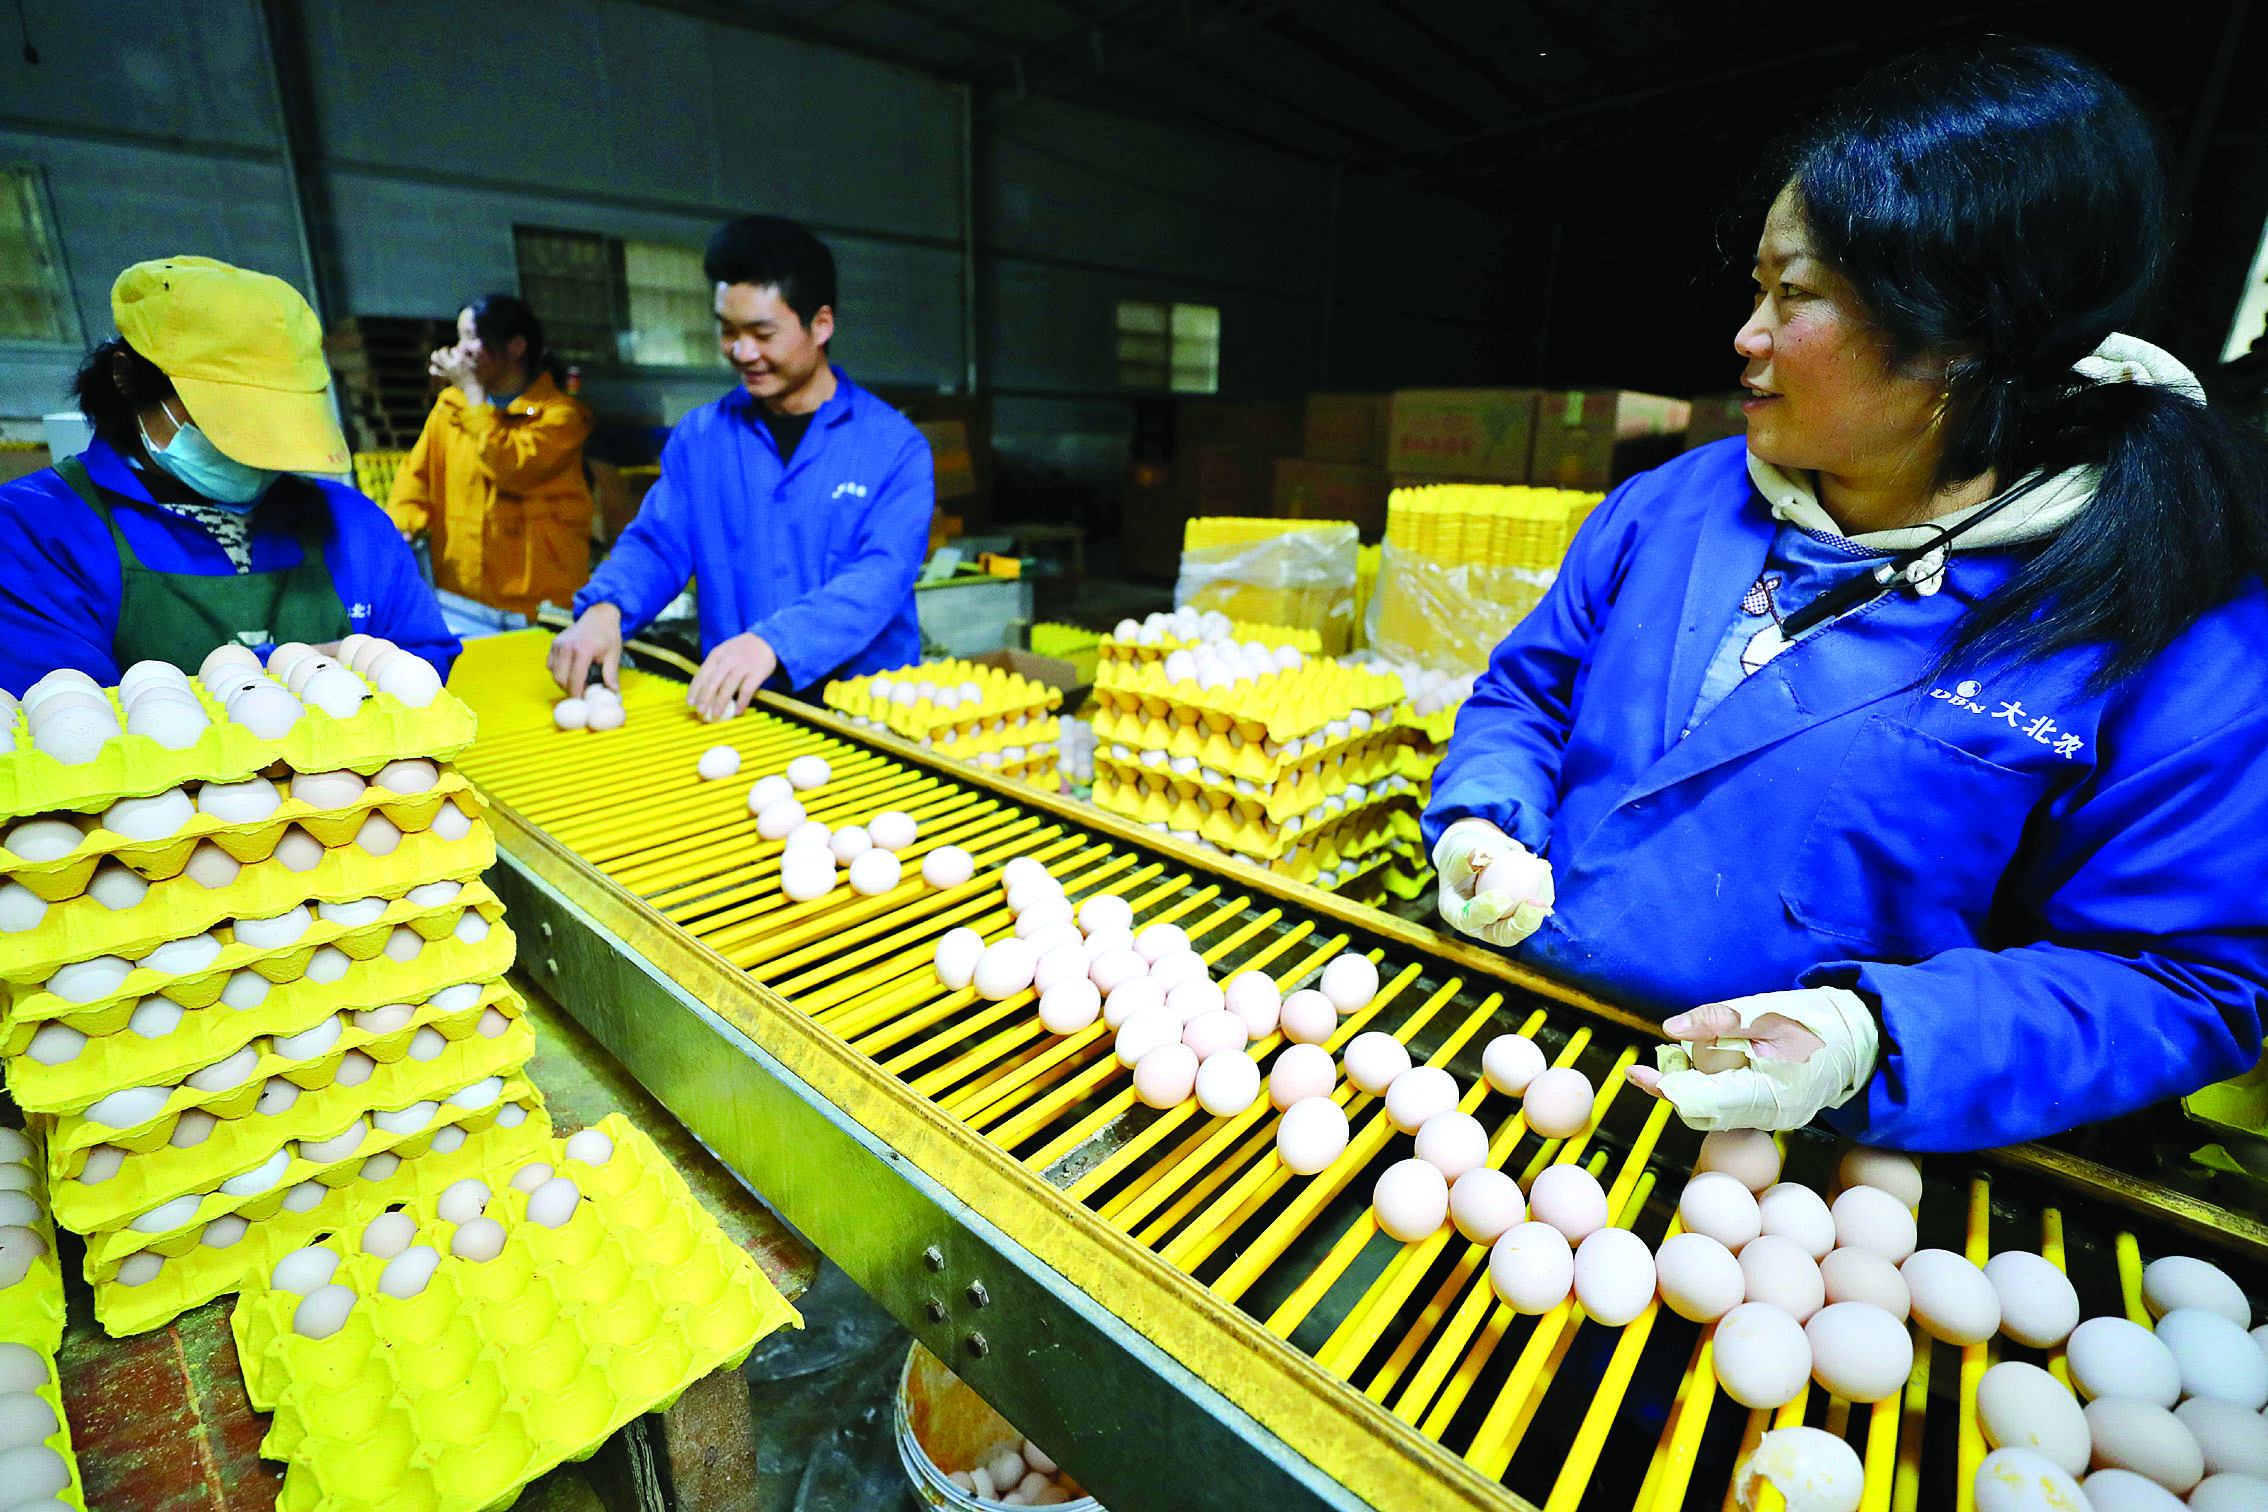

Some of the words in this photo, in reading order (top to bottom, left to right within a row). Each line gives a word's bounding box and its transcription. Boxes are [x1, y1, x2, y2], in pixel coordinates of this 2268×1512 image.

[1930, 688, 1986, 713] DBN
[1991, 701, 2084, 759] 大北农
